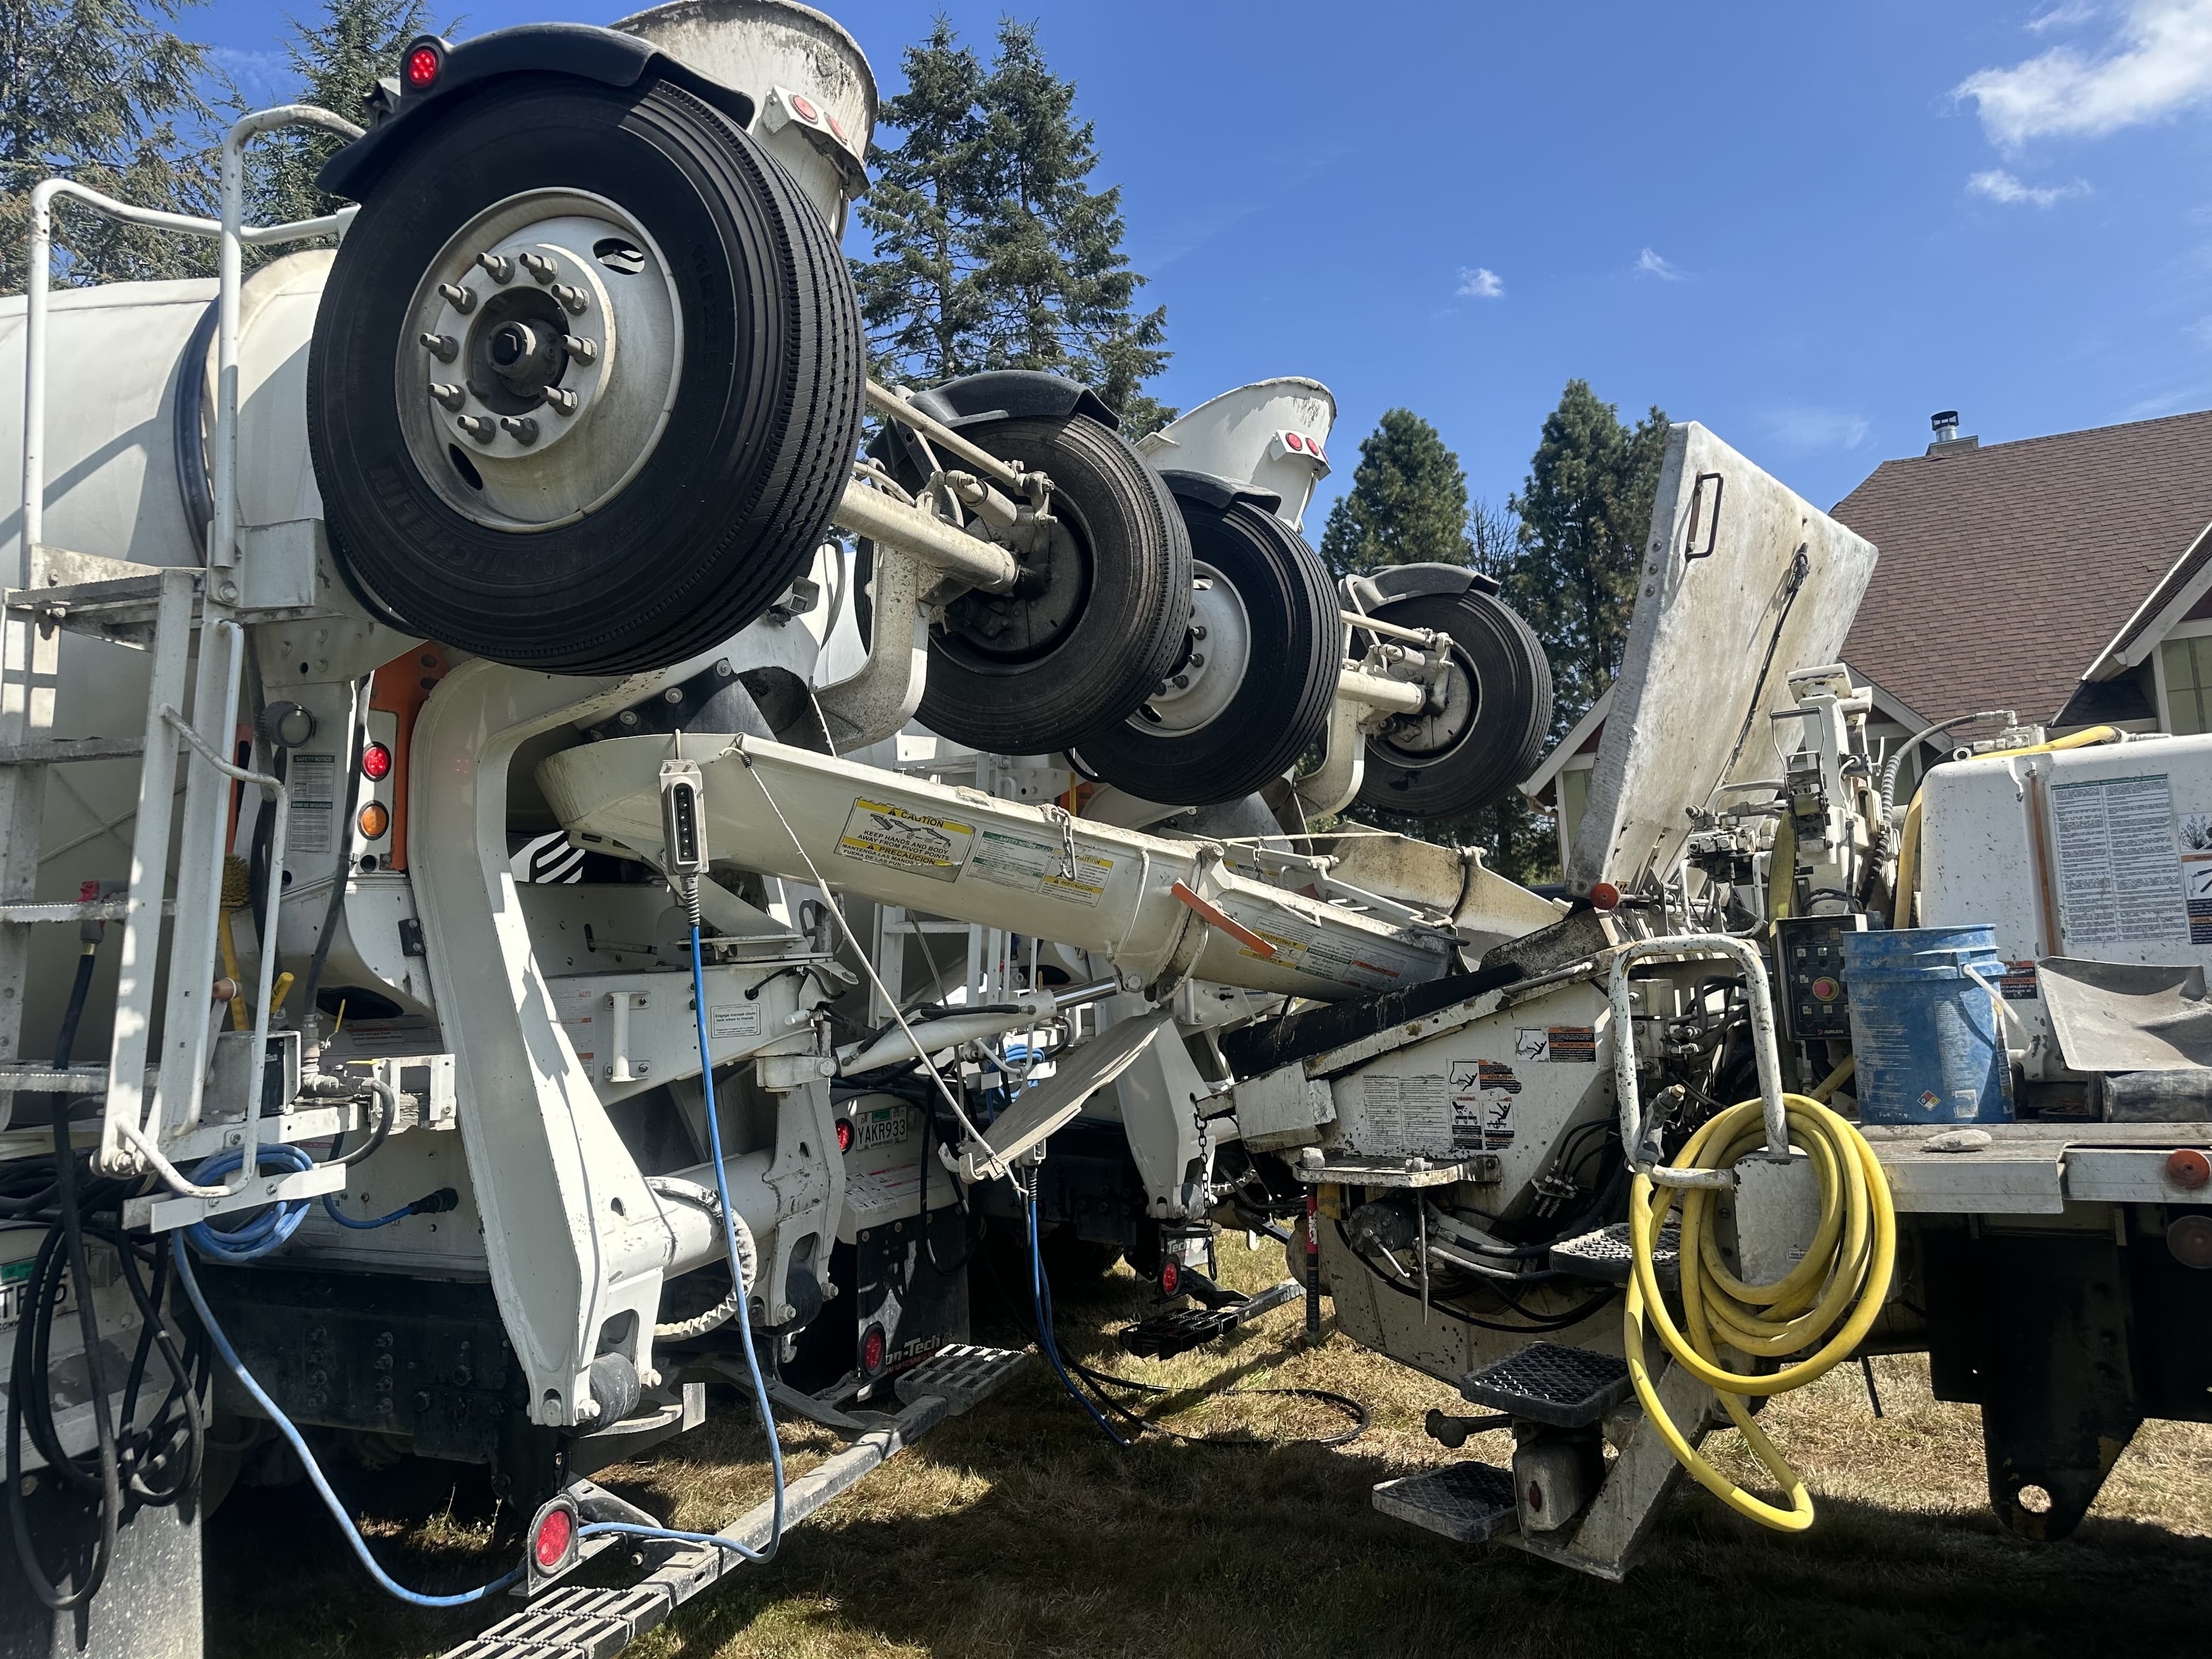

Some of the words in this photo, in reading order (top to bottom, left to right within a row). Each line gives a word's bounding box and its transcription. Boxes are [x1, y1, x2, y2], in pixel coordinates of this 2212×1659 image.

[366, 463, 532, 578] MICHELIN
[900, 811, 944, 828] CAUTION
[857, 834, 878, 843] AWAY
[879, 839, 900, 849] FROM
[902, 843, 922, 853] PIVOT
[924, 849, 950, 861] POINTS
[864, 830, 885, 839] KEEP
[885, 835, 910, 845] HANDS
[911, 840, 927, 849] AND
[928, 844, 948, 855] BODY
[999, 836, 1018, 846] SAFETY
[842, 843, 876, 855] MANTENGA
[892, 855, 915, 865] MANOS
[843, 849, 863, 857] FUERA
[1076, 855, 1101, 865] AUTION
[1252, 952, 1277, 963] CAUTION
[858, 1119, 905, 1144] YAKR933
[885, 1335, 941, 1365] on-Tech
